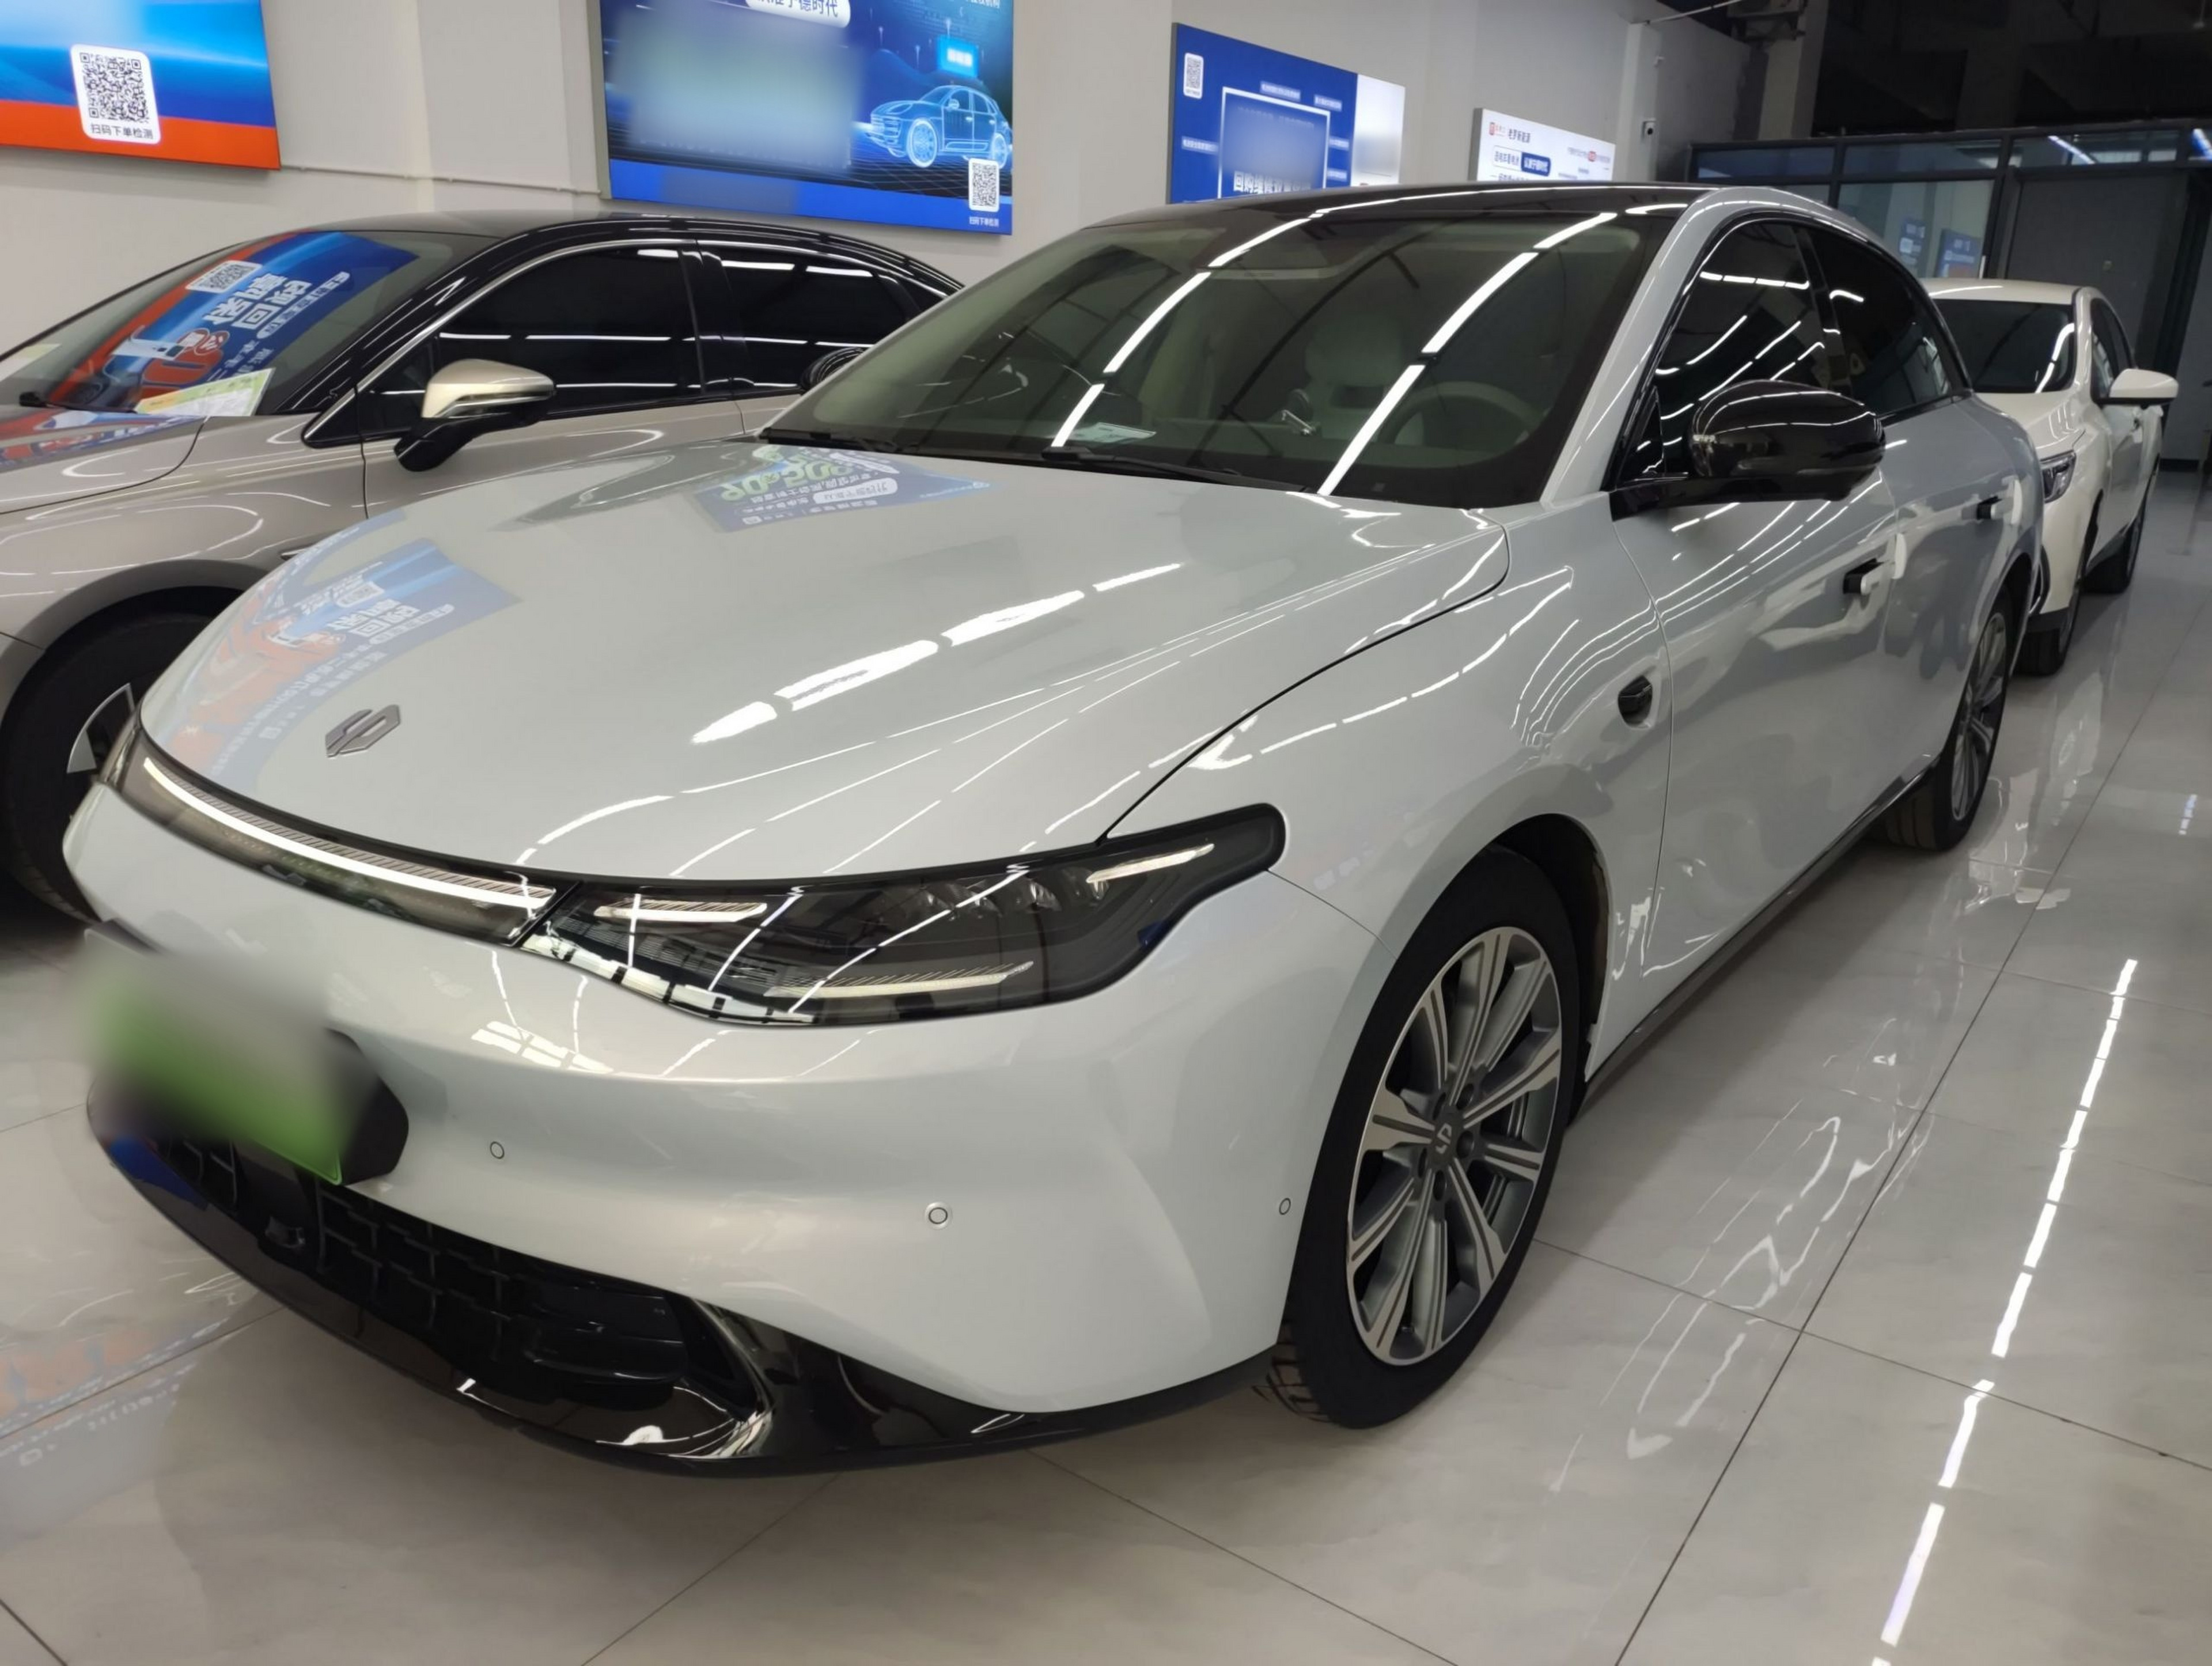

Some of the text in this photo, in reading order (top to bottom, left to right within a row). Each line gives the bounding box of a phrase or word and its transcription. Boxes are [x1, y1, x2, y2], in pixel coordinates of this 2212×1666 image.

[757, 0, 838, 18] 德时代
[90, 123, 153, 139] 扫码下单检测
